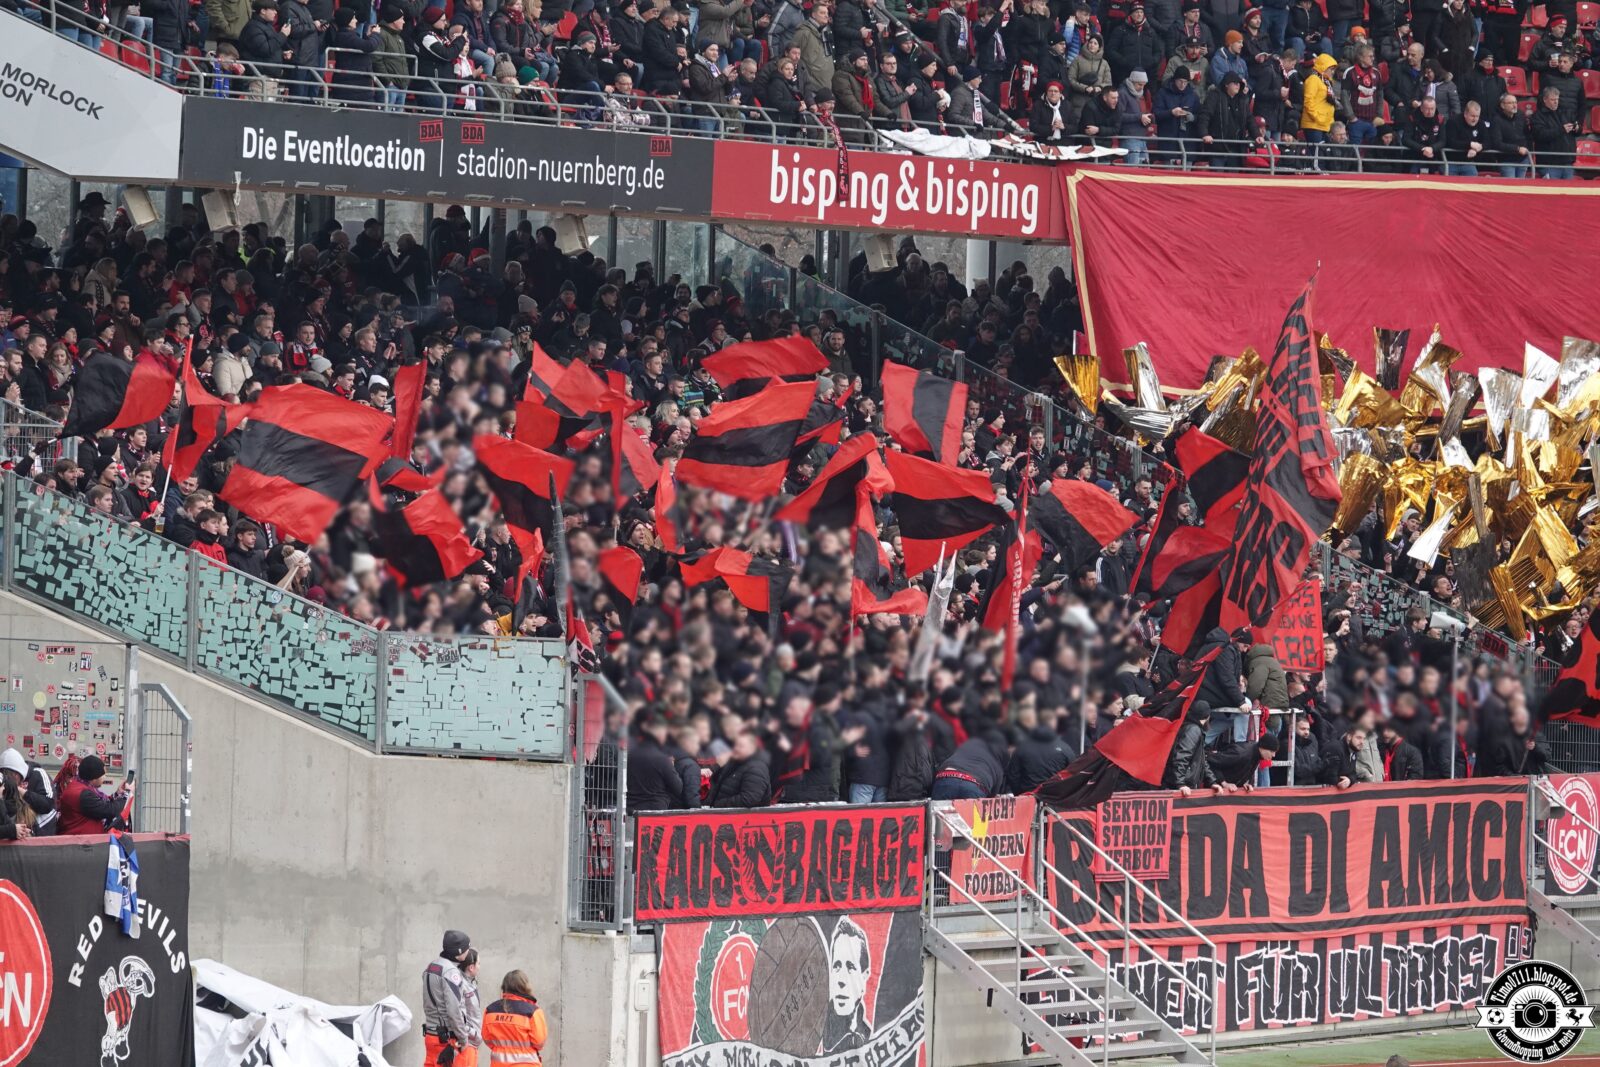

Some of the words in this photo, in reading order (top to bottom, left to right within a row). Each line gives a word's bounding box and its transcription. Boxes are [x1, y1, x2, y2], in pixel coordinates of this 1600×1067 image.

[1, 62, 104, 120] MORLOCK
[242, 126, 277, 160] Die
[283, 129, 426, 172] Eventlocation
[420, 122, 442, 139] BDA
[461, 126, 484, 141] BDA
[650, 138, 672, 153] BDA
[456, 147, 665, 196] stadion-nuernberg.de
[769, 149, 889, 225] bispng
[895, 159, 920, 211] &
[926, 160, 1039, 235] bisping
[981, 797, 1017, 823] FIGHT
[1101, 799, 1168, 823] SEKTION
[1102, 824, 1167, 847] STADION
[1559, 829, 1588, 861] FCN
[637, 823, 736, 911] KAOS
[783, 814, 920, 905] BAGAGE
[1104, 848, 1163, 872] VERBOT
[1288, 809, 1351, 918] DI
[1367, 800, 1525, 909] AMICI
[68, 914, 103, 988] RED
[136, 898, 186, 974] EVILS
[1235, 940, 1320, 1025] FÜR
